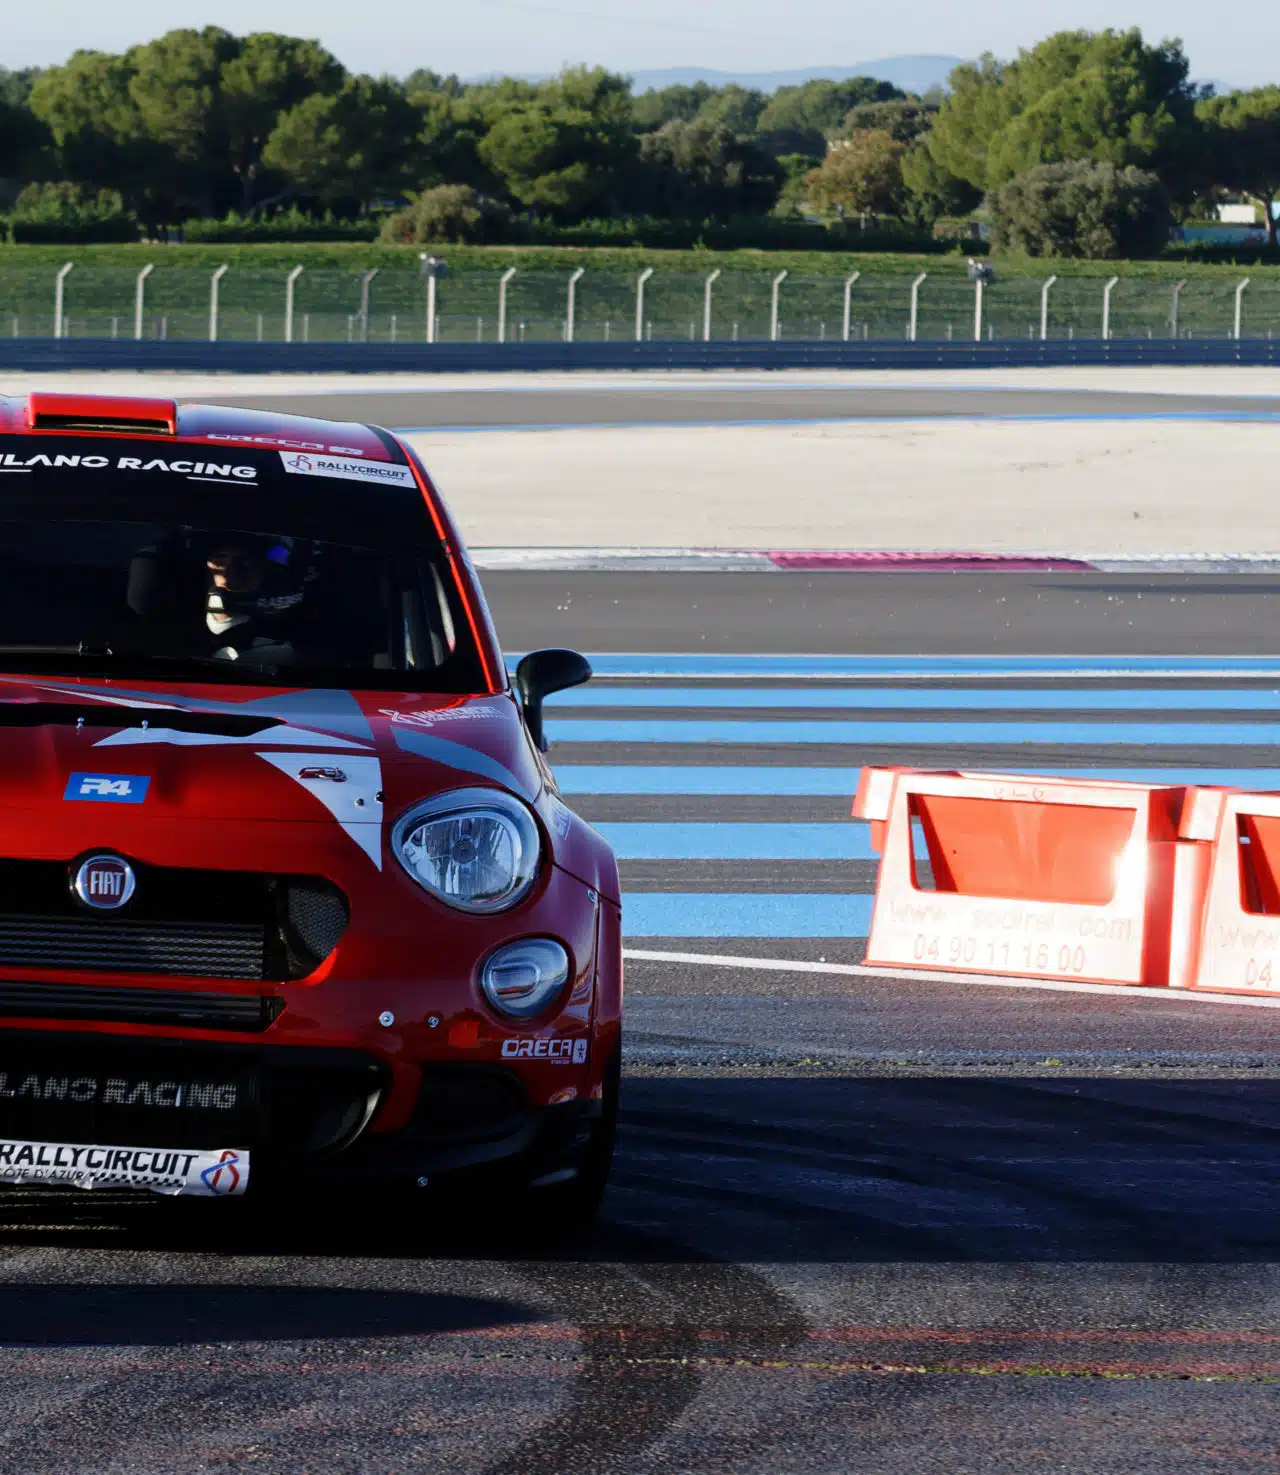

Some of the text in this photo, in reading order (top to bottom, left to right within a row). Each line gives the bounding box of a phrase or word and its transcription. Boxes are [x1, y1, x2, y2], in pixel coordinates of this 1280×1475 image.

[117, 457, 257, 479] RACING
[317, 461, 408, 479] RALLYCIRCUIT
[90, 870, 124, 896] FIAT
[913, 933, 1086, 973] 04 90 11 16 00
[500, 1039, 573, 1057] ORECA
[103, 1078, 237, 1109] RACING
